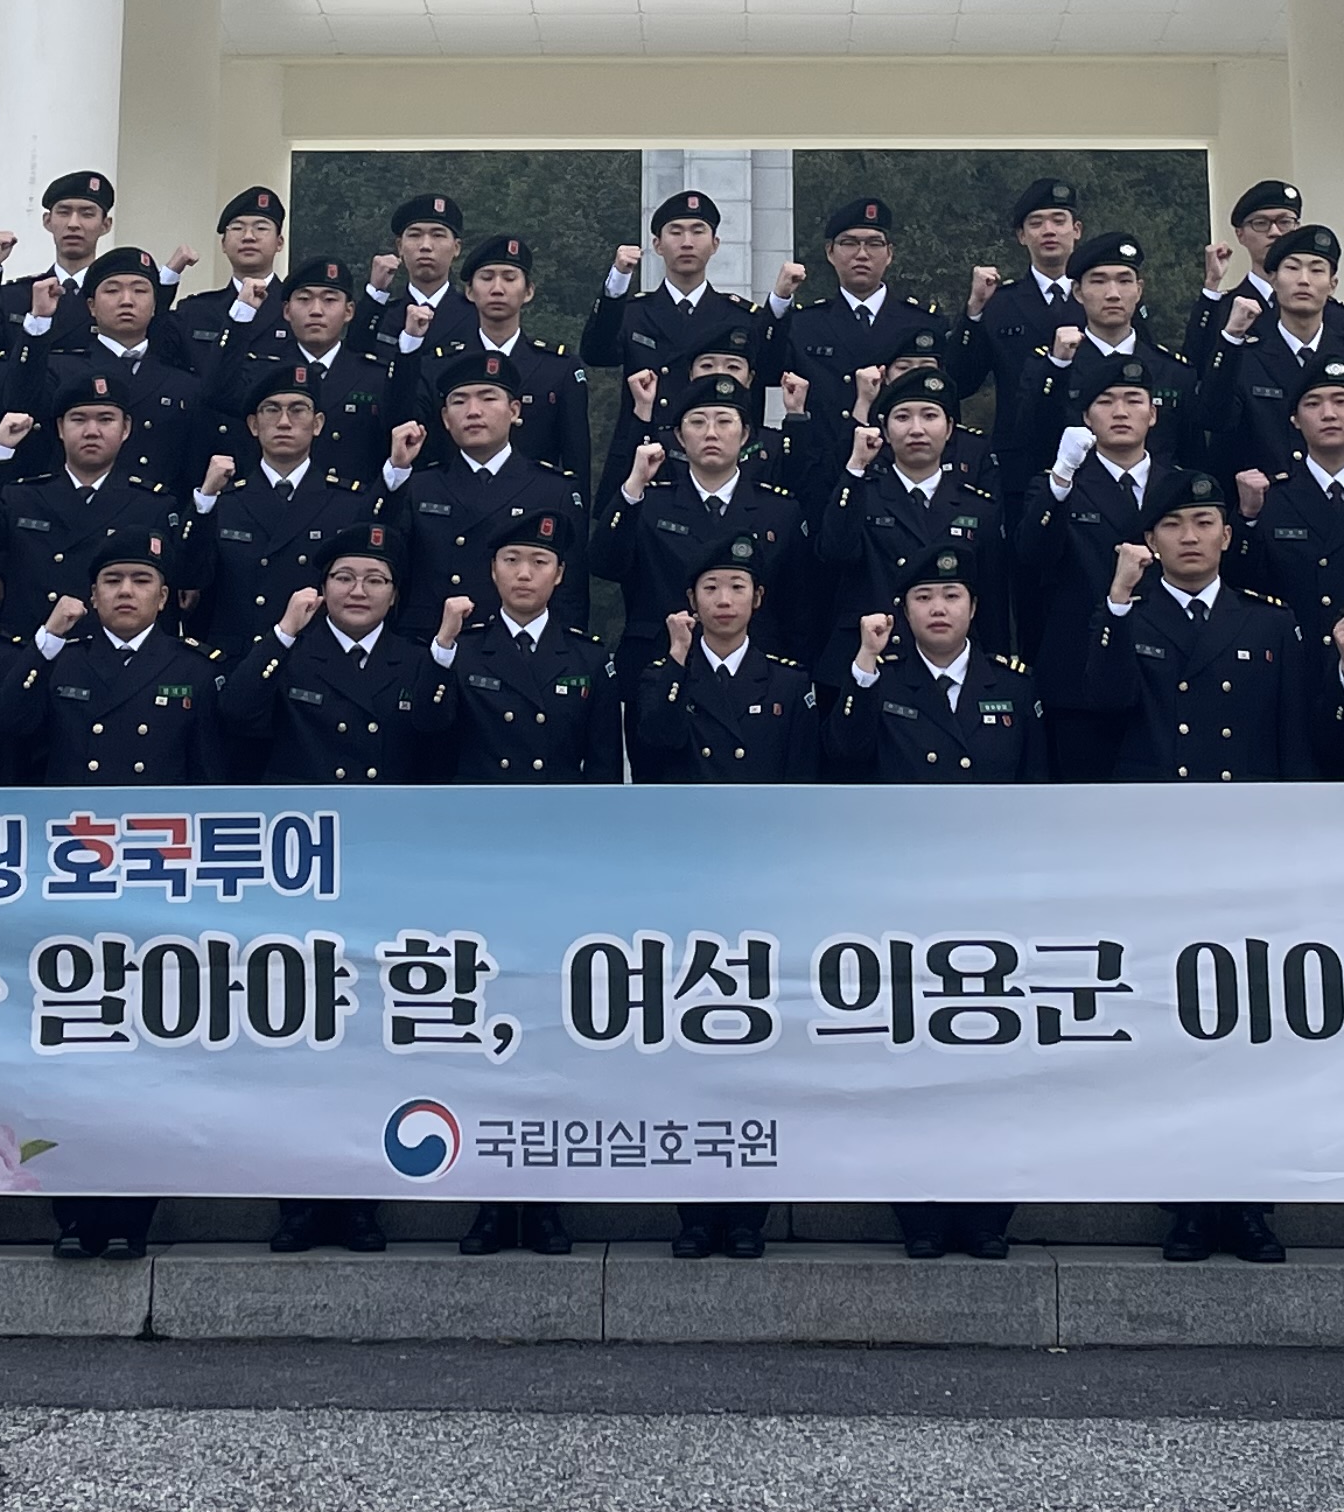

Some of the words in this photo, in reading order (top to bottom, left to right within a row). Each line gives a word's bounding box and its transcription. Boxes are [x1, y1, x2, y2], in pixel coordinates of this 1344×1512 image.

[47, 815, 335, 898] 호국투어
[35, 939, 351, 1045] 알아야
[383, 937, 514, 1054] 할,
[569, 938, 774, 1046] 여성
[815, 938, 1134, 1046] 의용군
[475, 1119, 778, 1168] 국립임실호국원
